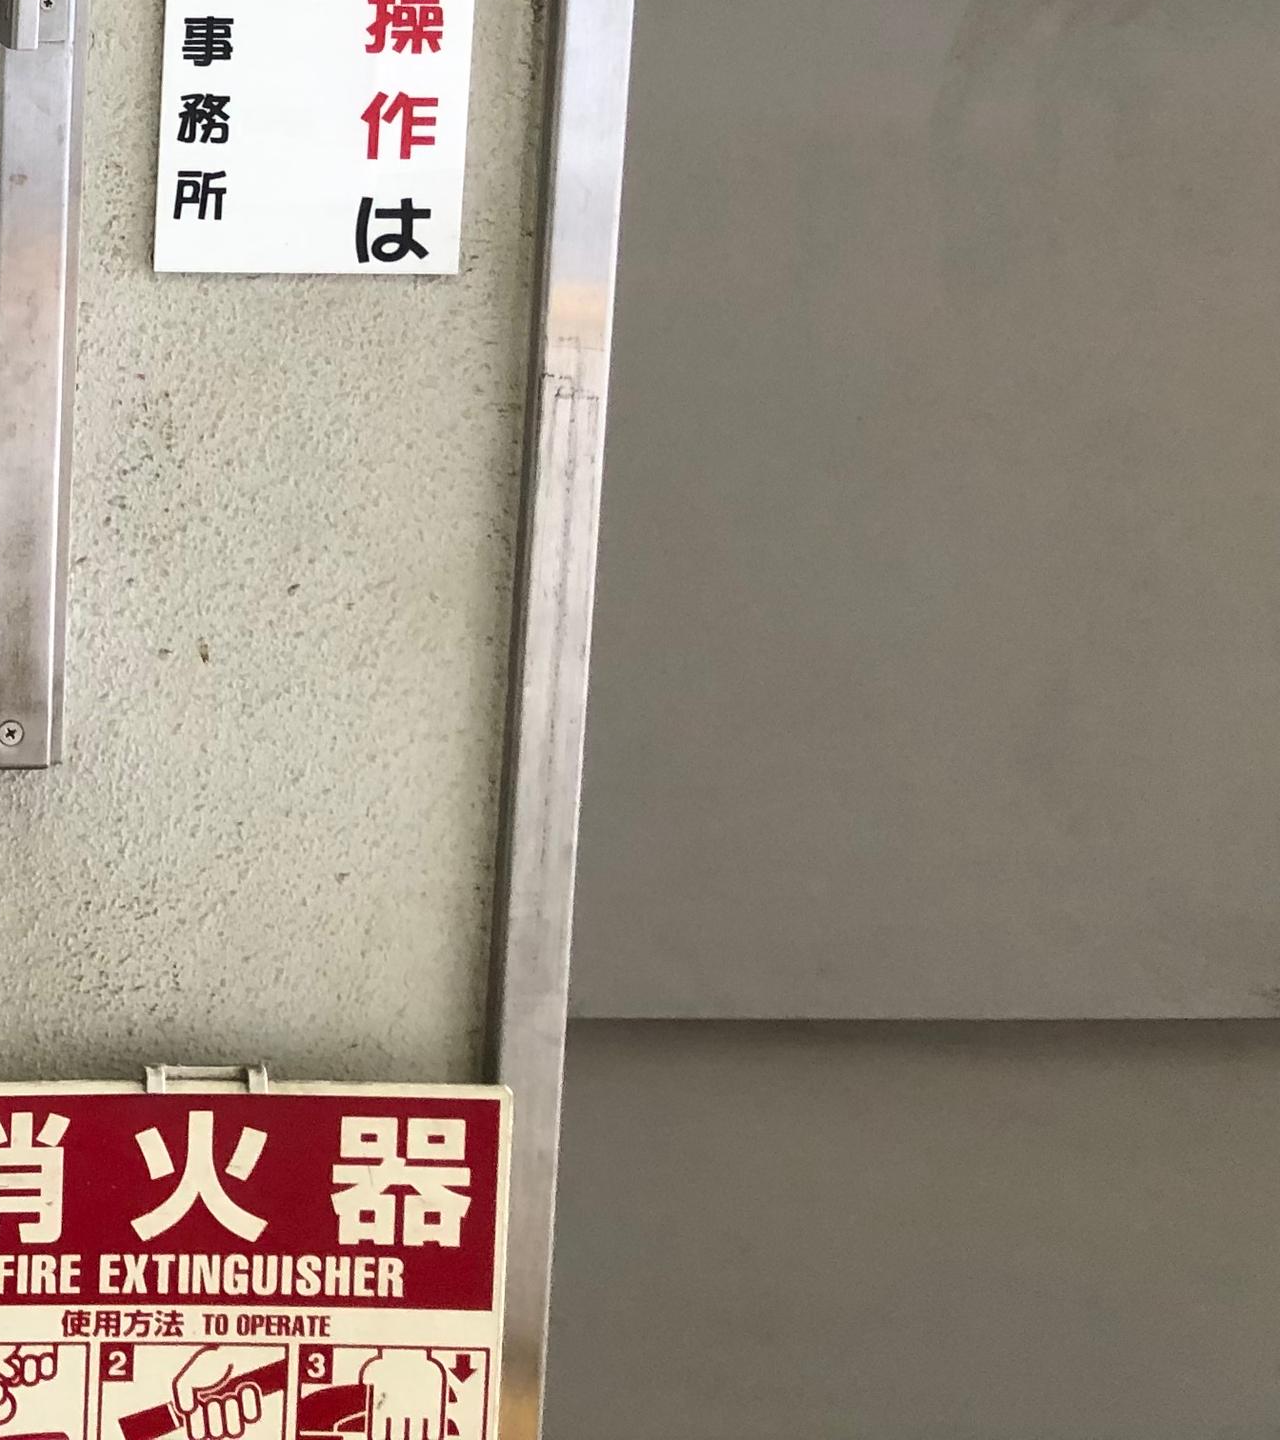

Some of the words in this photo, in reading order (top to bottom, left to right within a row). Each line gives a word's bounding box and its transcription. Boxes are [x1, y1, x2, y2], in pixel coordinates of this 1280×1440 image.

[97, 1253, 406, 1300] EXTINGUISHER
[60, 1310, 185, 1339] 使用方法
[202, 1313, 229, 1338] TO
[235, 1313, 332, 1338] OPERATE
[108, 1353, 127, 1378] 2
[305, 1353, 327, 1379] 3
